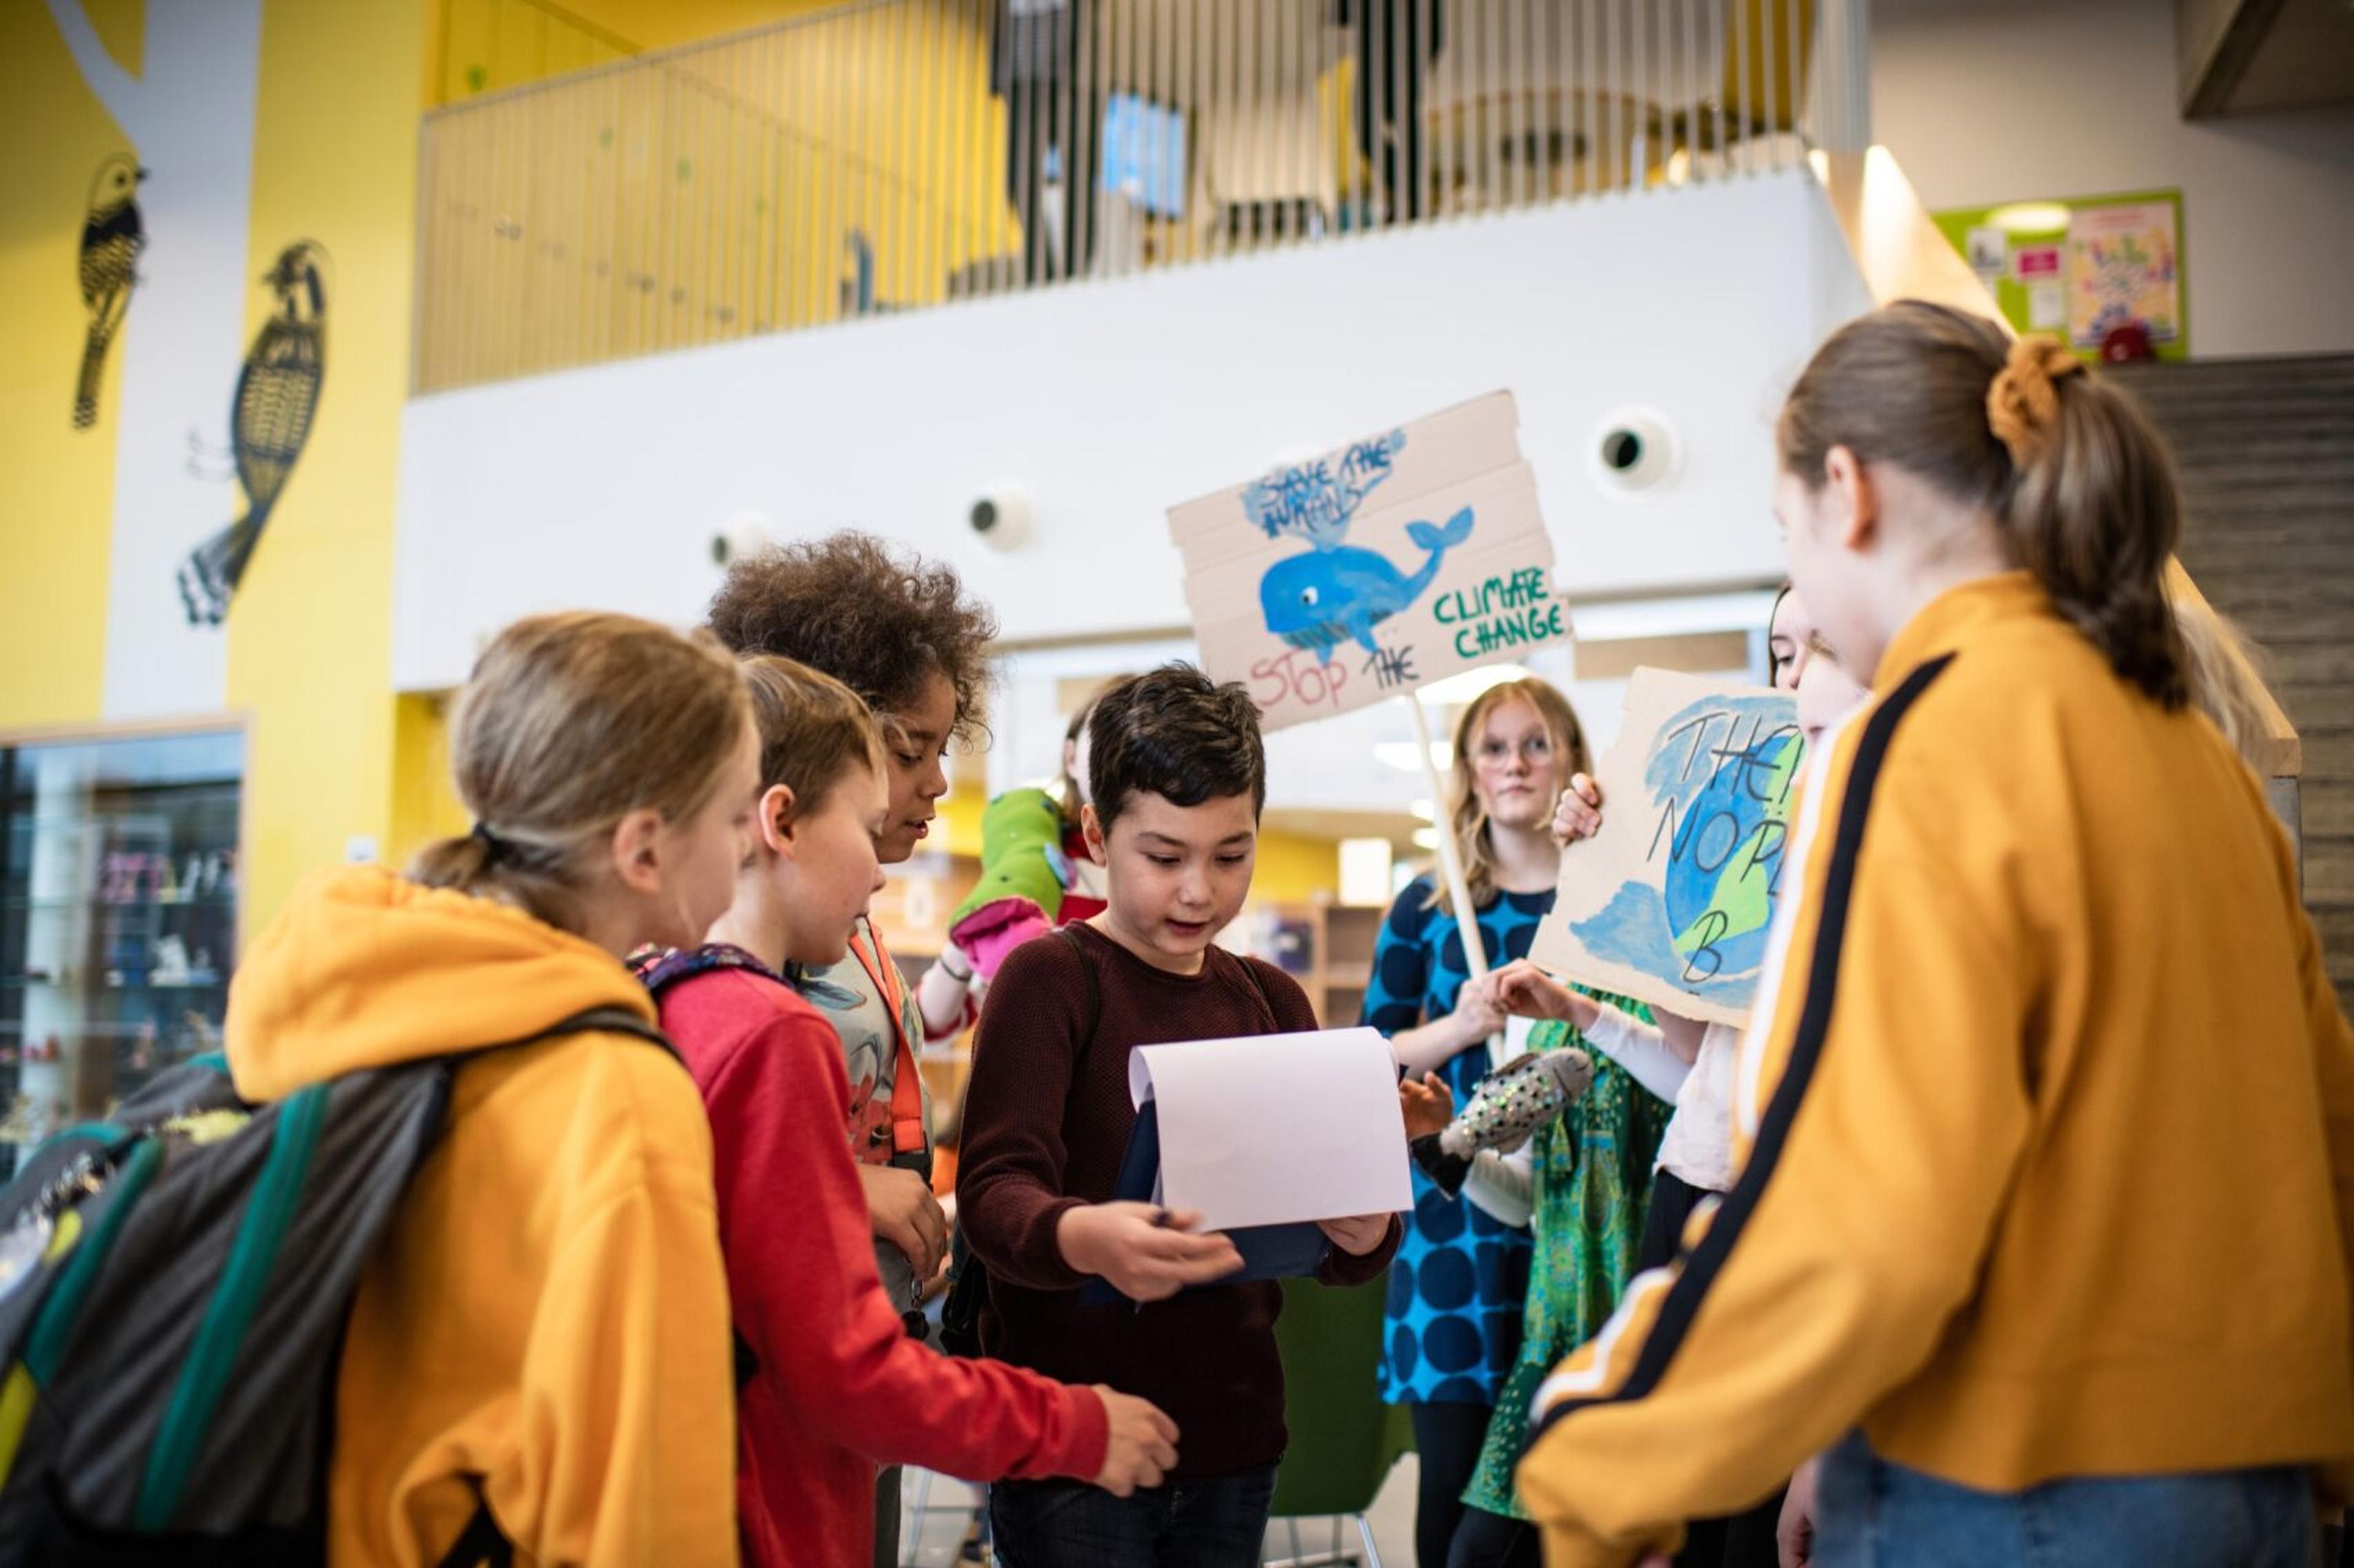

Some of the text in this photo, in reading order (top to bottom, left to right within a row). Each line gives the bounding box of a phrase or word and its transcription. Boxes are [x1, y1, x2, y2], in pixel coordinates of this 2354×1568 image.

[1260, 436, 1390, 509] SAVE THE
[1433, 567, 1548, 623] CLIMATE
[1455, 604, 1563, 658] CHANGE
[1251, 645, 1419, 707] STOP THE
[1647, 796, 1739, 873] NO
[1682, 910, 1728, 983] B
